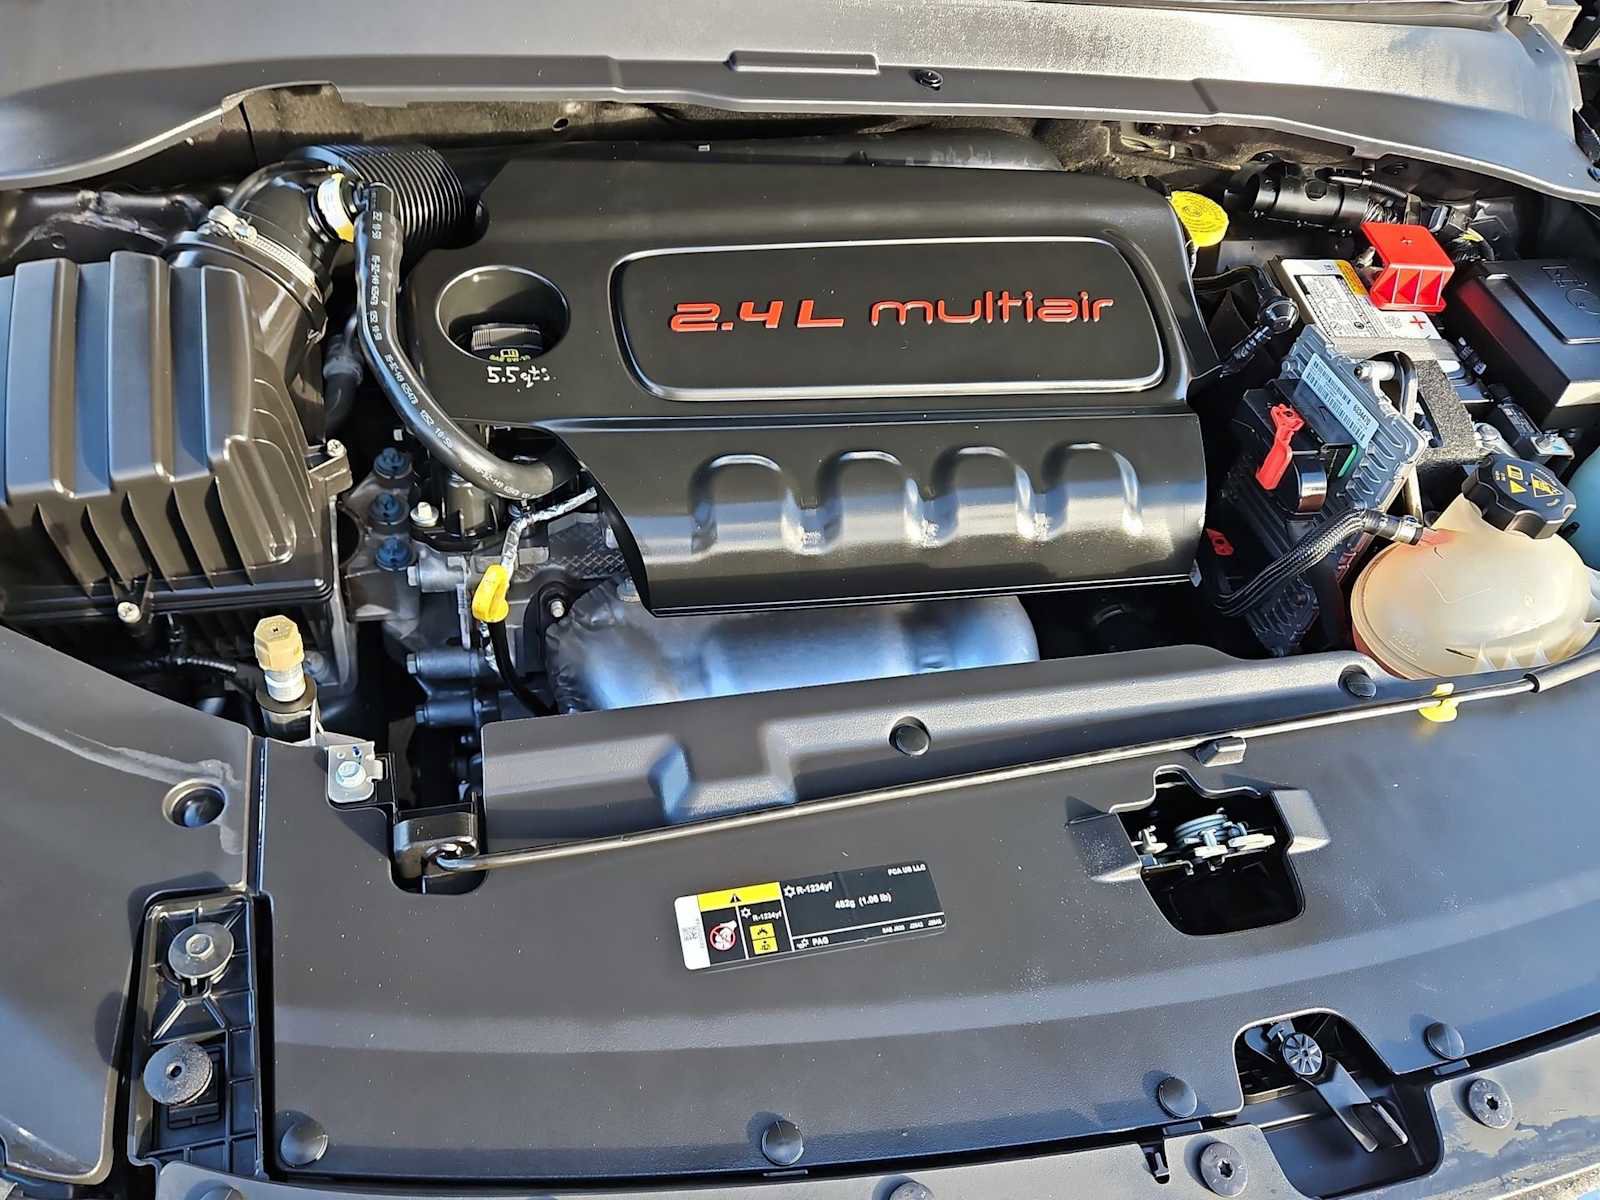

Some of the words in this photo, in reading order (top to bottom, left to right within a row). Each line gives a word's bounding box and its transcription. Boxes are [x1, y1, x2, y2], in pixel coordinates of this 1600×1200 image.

[870, 290, 1114, 327] multiair
[487, 365, 520, 384] 5.5
[796, 881, 833, 896] R-1234yf
[812, 936, 829, 947] PAG
